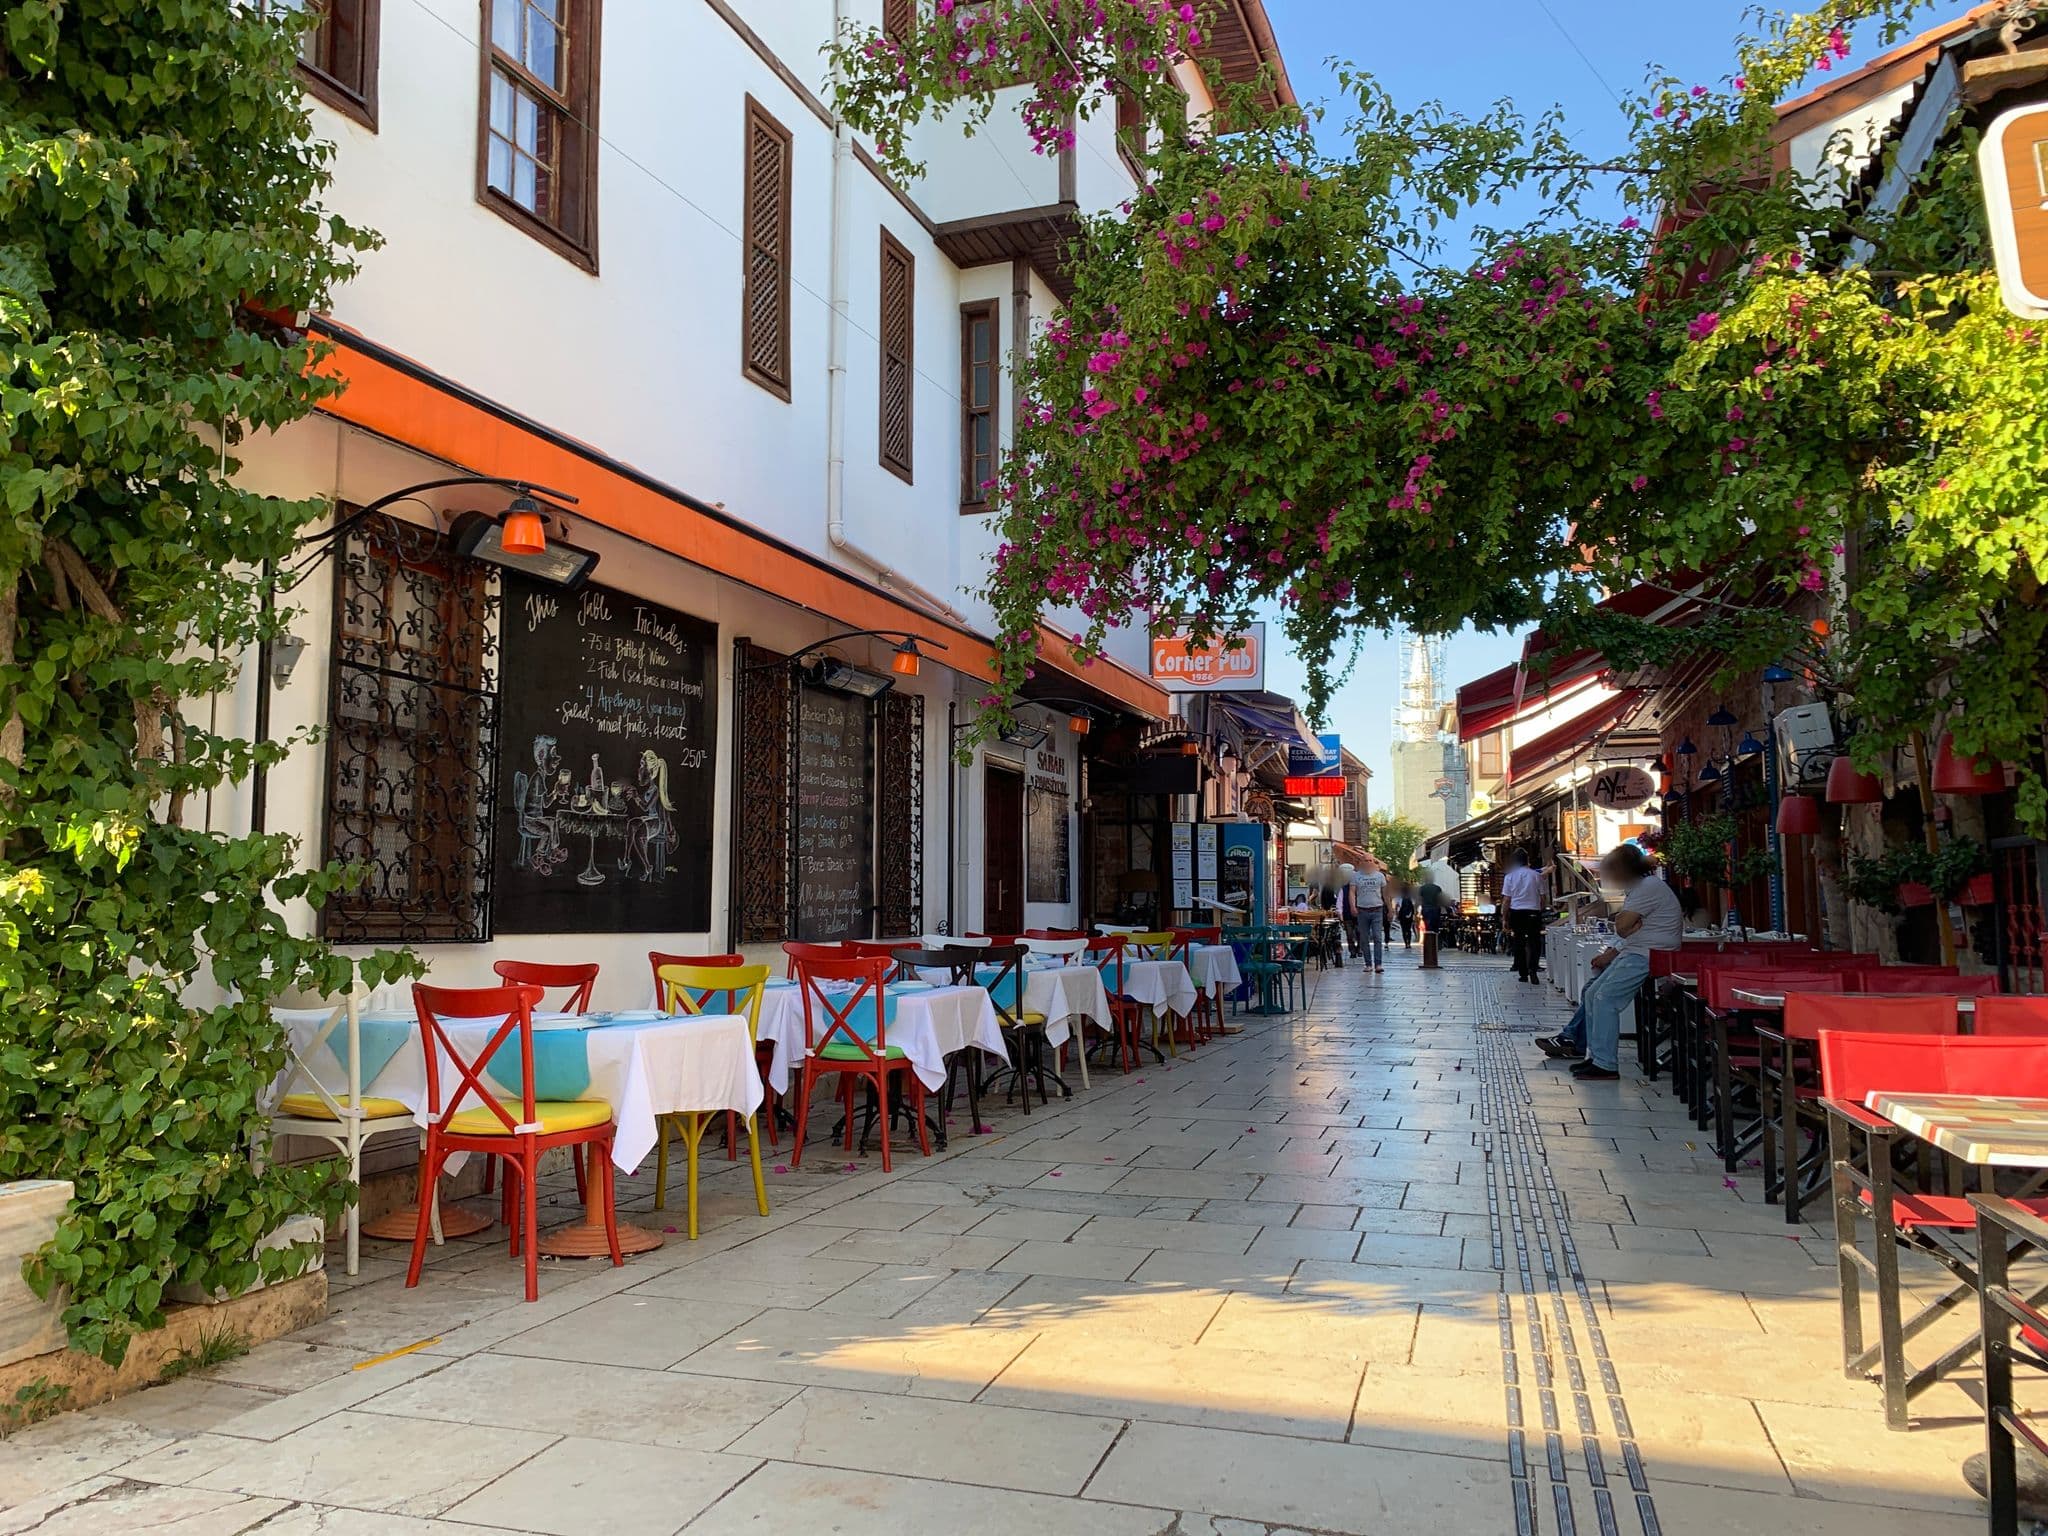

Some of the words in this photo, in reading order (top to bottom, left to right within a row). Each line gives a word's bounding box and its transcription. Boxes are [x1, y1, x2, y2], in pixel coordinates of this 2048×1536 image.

[525, 592, 560, 632] This
[577, 590, 613, 627] Table
[631, 606, 688, 655] Includes:
[587, 632, 603, 651] 75
[649, 647, 670, 667] Wine
[1155, 648, 1214, 673] Corner
[1218, 646, 1252, 672] Pub
[586, 657, 597, 673] 2
[597, 660, 621, 680] Fish
[586, 685, 594, 708] 4
[561, 700, 595, 725] Salad,
[596, 715, 623, 735] mixed
[1037, 751, 1065, 777] SABAH
